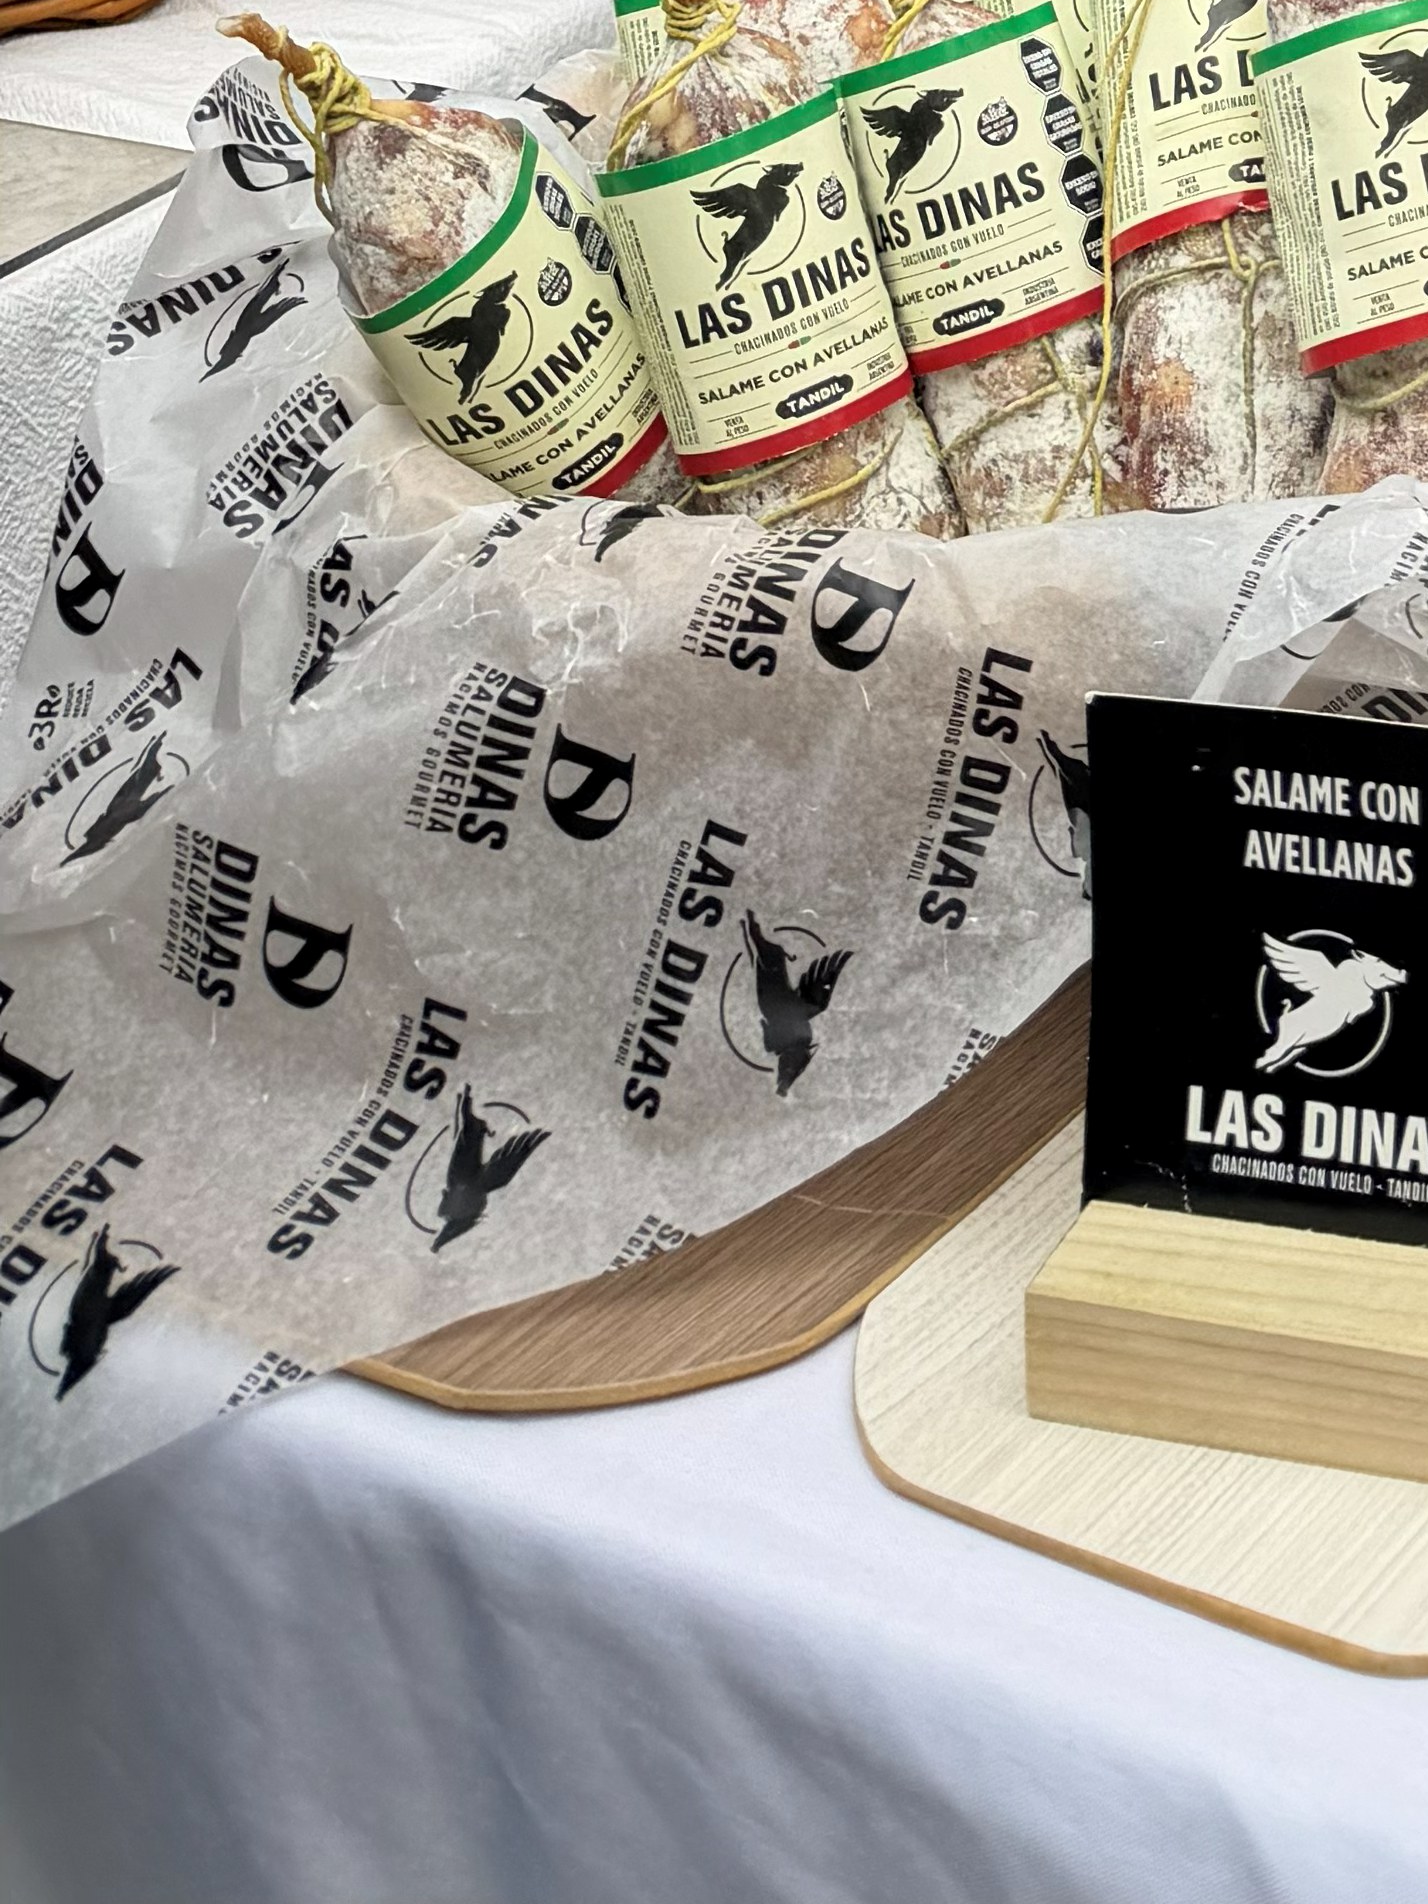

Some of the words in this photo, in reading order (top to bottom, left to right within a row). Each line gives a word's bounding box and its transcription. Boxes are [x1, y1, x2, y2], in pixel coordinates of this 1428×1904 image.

[1149, 55, 1222, 111] LAS
[1202, 94, 1256, 115] CHACINADO
[1158, 136, 1224, 167] SALAME
[1331, 161, 1408, 221] LAS
[916, 161, 1045, 240] DINAS
[973, 223, 1004, 245] VUELO
[674, 292, 753, 349] LAS
[761, 237, 871, 321] DINAS
[925, 281, 958, 299] CON
[963, 241, 1063, 290] AVELLANAS
[1347, 250, 1415, 281] SALAME
[734, 323, 796, 355] CHACINADOS
[800, 313, 821, 330] CON
[821, 298, 849, 320] VUELO
[940, 305, 994, 331] TANDIL
[426, 403, 505, 445] LAS
[504, 298, 614, 418] DINAS
[698, 375, 765, 405] SALAME
[769, 358, 808, 383] CON
[813, 316, 889, 367] AVELLANAS
[787, 381, 844, 413] TANDIL
[535, 438, 571, 466] CON
[577, 352, 646, 442] AVELLANAS
[563, 445, 616, 485] TANDIL
[124, 647, 204, 733] LAS
[972, 645, 1034, 745] LAS
[425, 667, 508, 835] SALUMERIA
[457, 675, 549, 851] DINAS
[1233, 766, 1352, 818] SALAME
[1359, 780, 1421, 826] CON
[676, 818, 749, 928] LAS
[919, 754, 1014, 931] DINAS
[1243, 829, 1415, 887] AVELLANAS
[174, 829, 214, 985] SALUMERIA
[194, 839, 259, 1009] DINAS
[403, 997, 468, 1102] LAS
[621, 937, 709, 1121] DINAS
[1185, 1085, 1284, 1153] LAS
[41, 1143, 145, 1237] LAS
[266, 1108, 420, 1261] DINAS
[1212, 1153, 1294, 1184] CHACINADOS
[1299, 1164, 1326, 1188] CON
[1331, 1168, 1372, 1194] VUELO
